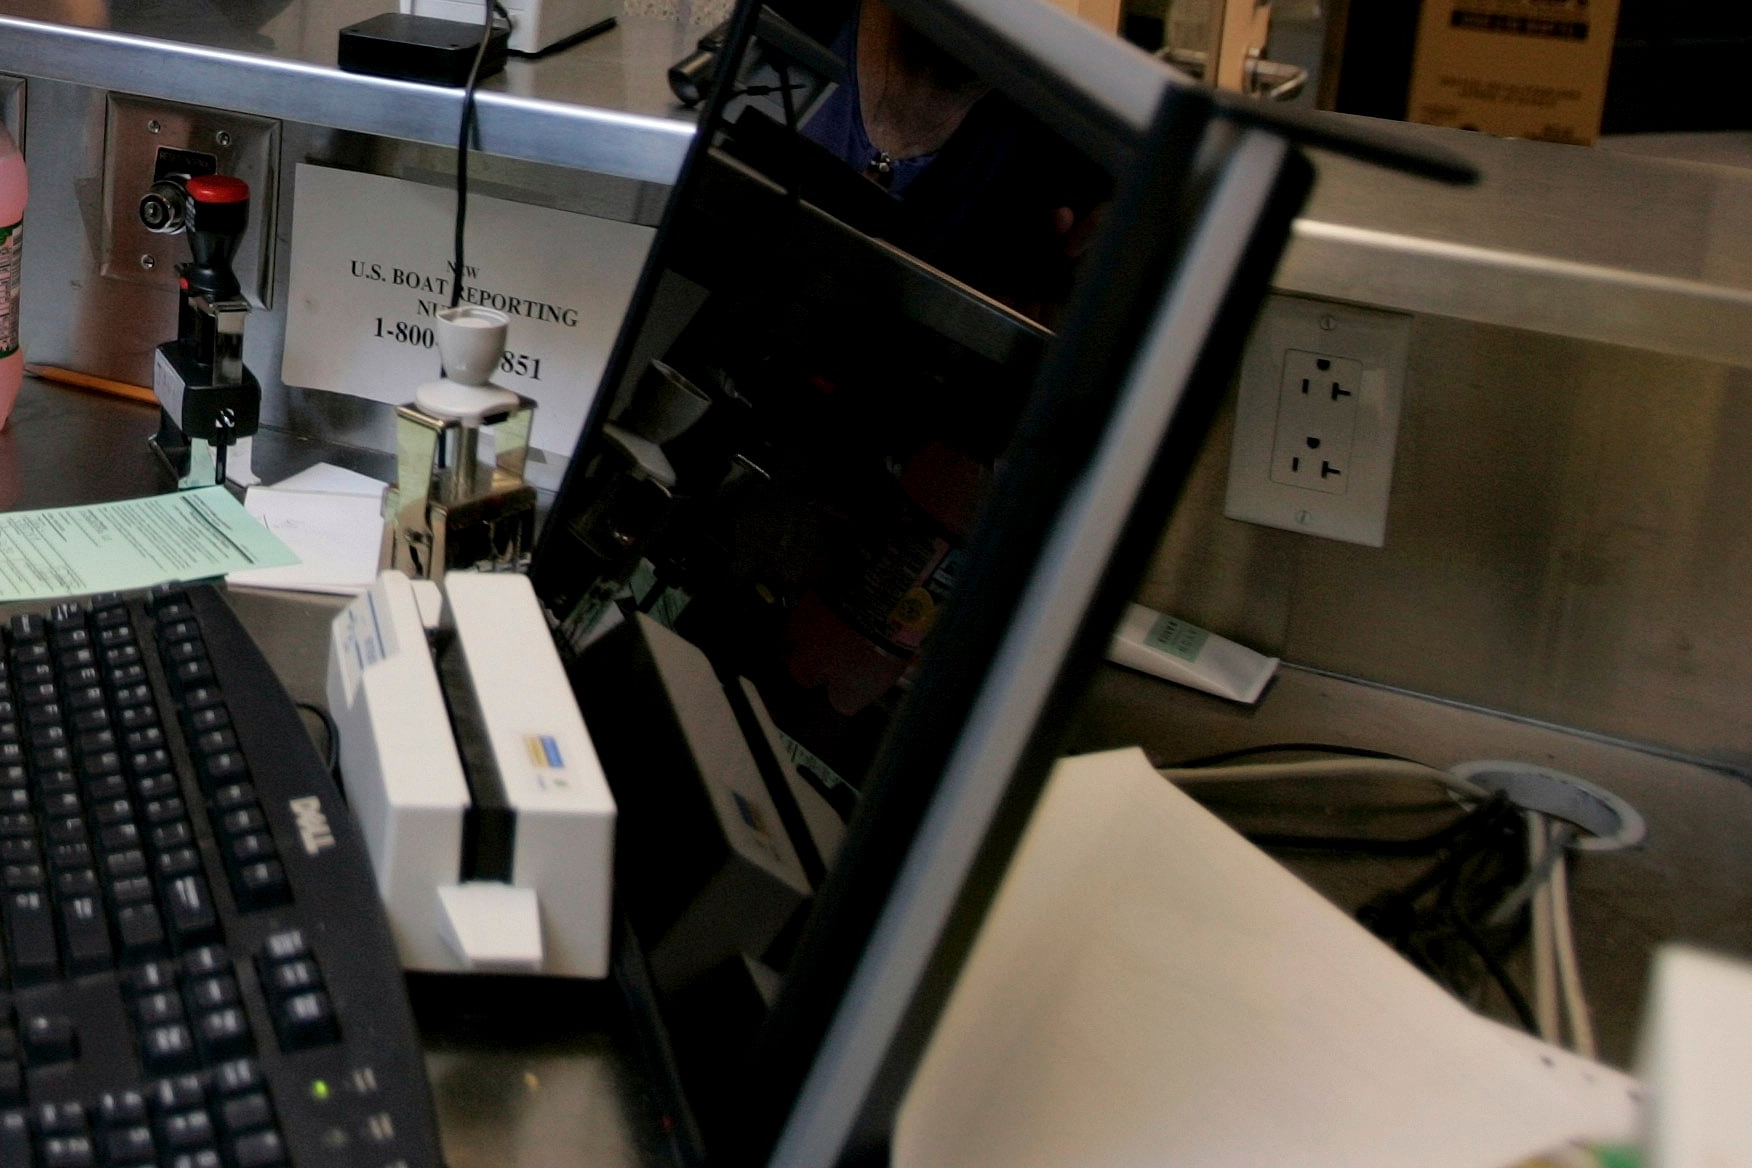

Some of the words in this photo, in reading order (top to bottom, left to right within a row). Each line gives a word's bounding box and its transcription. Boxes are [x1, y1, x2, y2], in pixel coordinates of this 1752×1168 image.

[446, 259, 480, 280] NW
[350, 259, 386, 283] U.S.
[391, 267, 448, 295] BOAT
[457, 284, 580, 328] REPORTING
